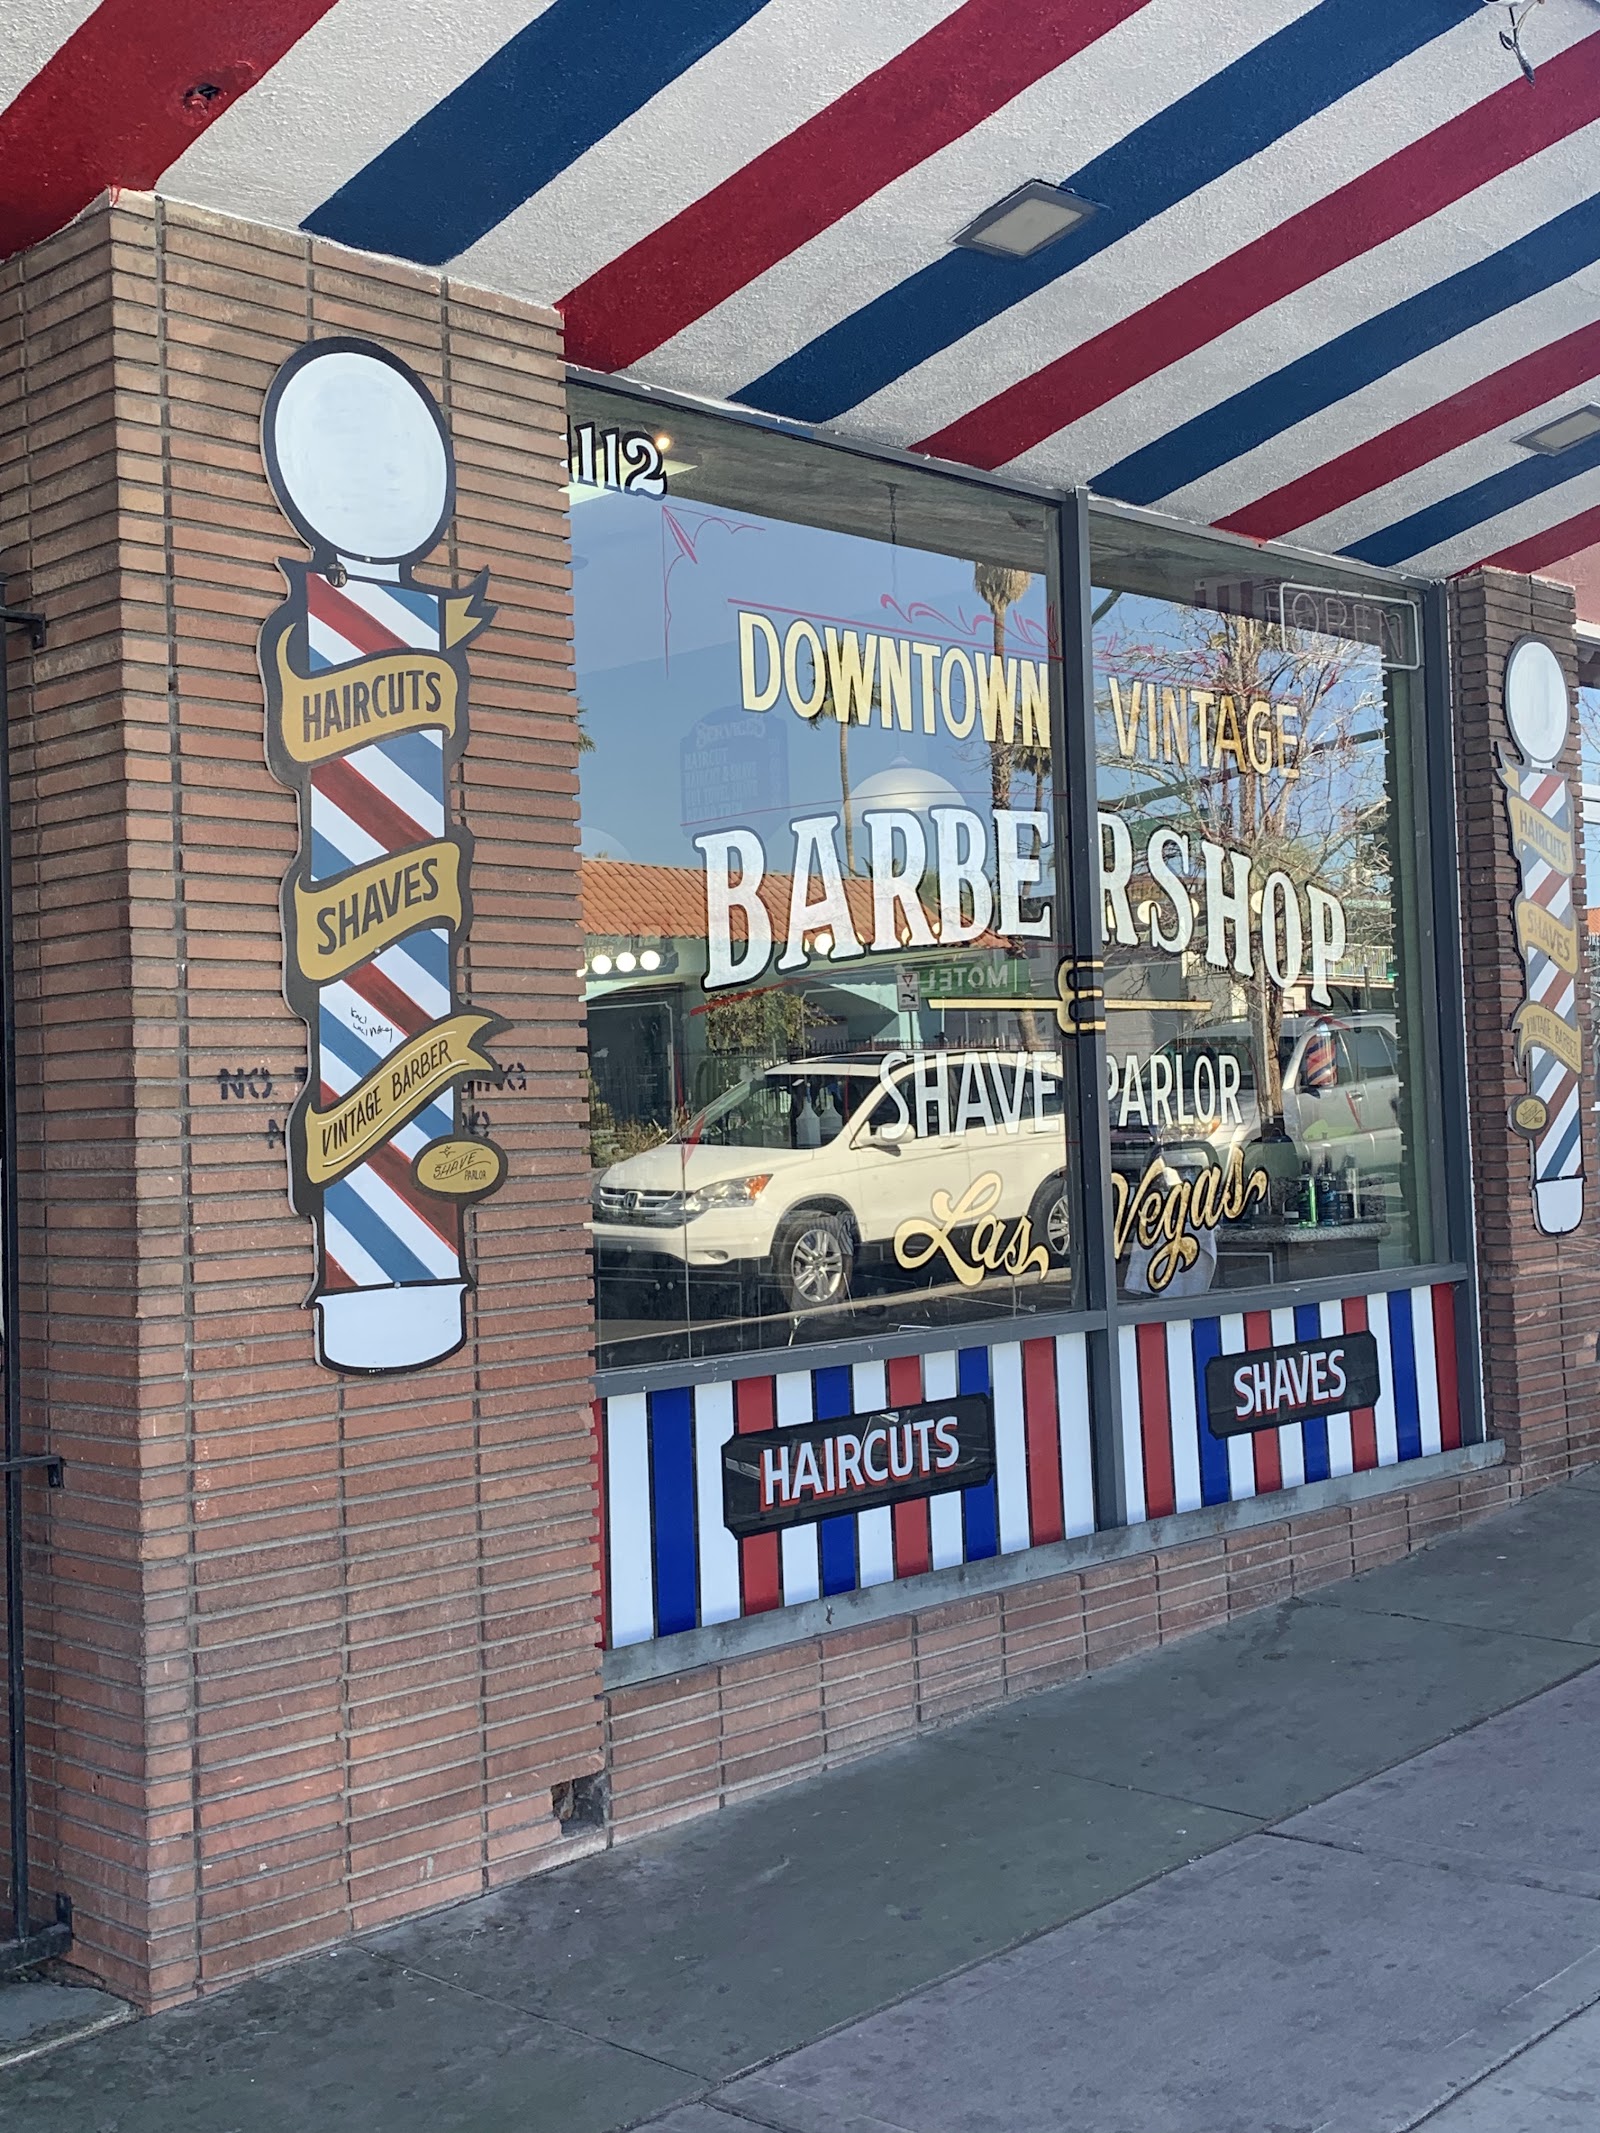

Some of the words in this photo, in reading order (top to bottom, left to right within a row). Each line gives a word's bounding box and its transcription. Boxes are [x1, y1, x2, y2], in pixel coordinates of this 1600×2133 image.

[567, 415, 668, 502] 112
[1292, 592, 1403, 659] OPEN
[303, 670, 441, 743] HAIRCUTS
[738, 609, 1053, 749] DOWNTOWN
[1108, 676, 1302, 778] VINTAGE
[1520, 809, 1568, 866] HAIRCUTS
[317, 858, 438, 955] SHAVES
[693, 804, 1347, 1008] BARBERSHOP
[1528, 910, 1570, 962] SHAVES
[219, 1067, 273, 1100] NO
[322, 1086, 383, 1157] VINTAGE
[391, 1039, 452, 1101] BARBER
[878, 1050, 1060, 1140] SHAVE
[433, 1151, 477, 1179] SHAVE
[464, 1169, 487, 1181] PARLOR
[894, 1171, 1049, 1287] Las
[1110, 1143, 1269, 1293] Vegas
[1234, 1350, 1347, 1421] SHAVES
[760, 1416, 960, 1512] HAIRCUTS
